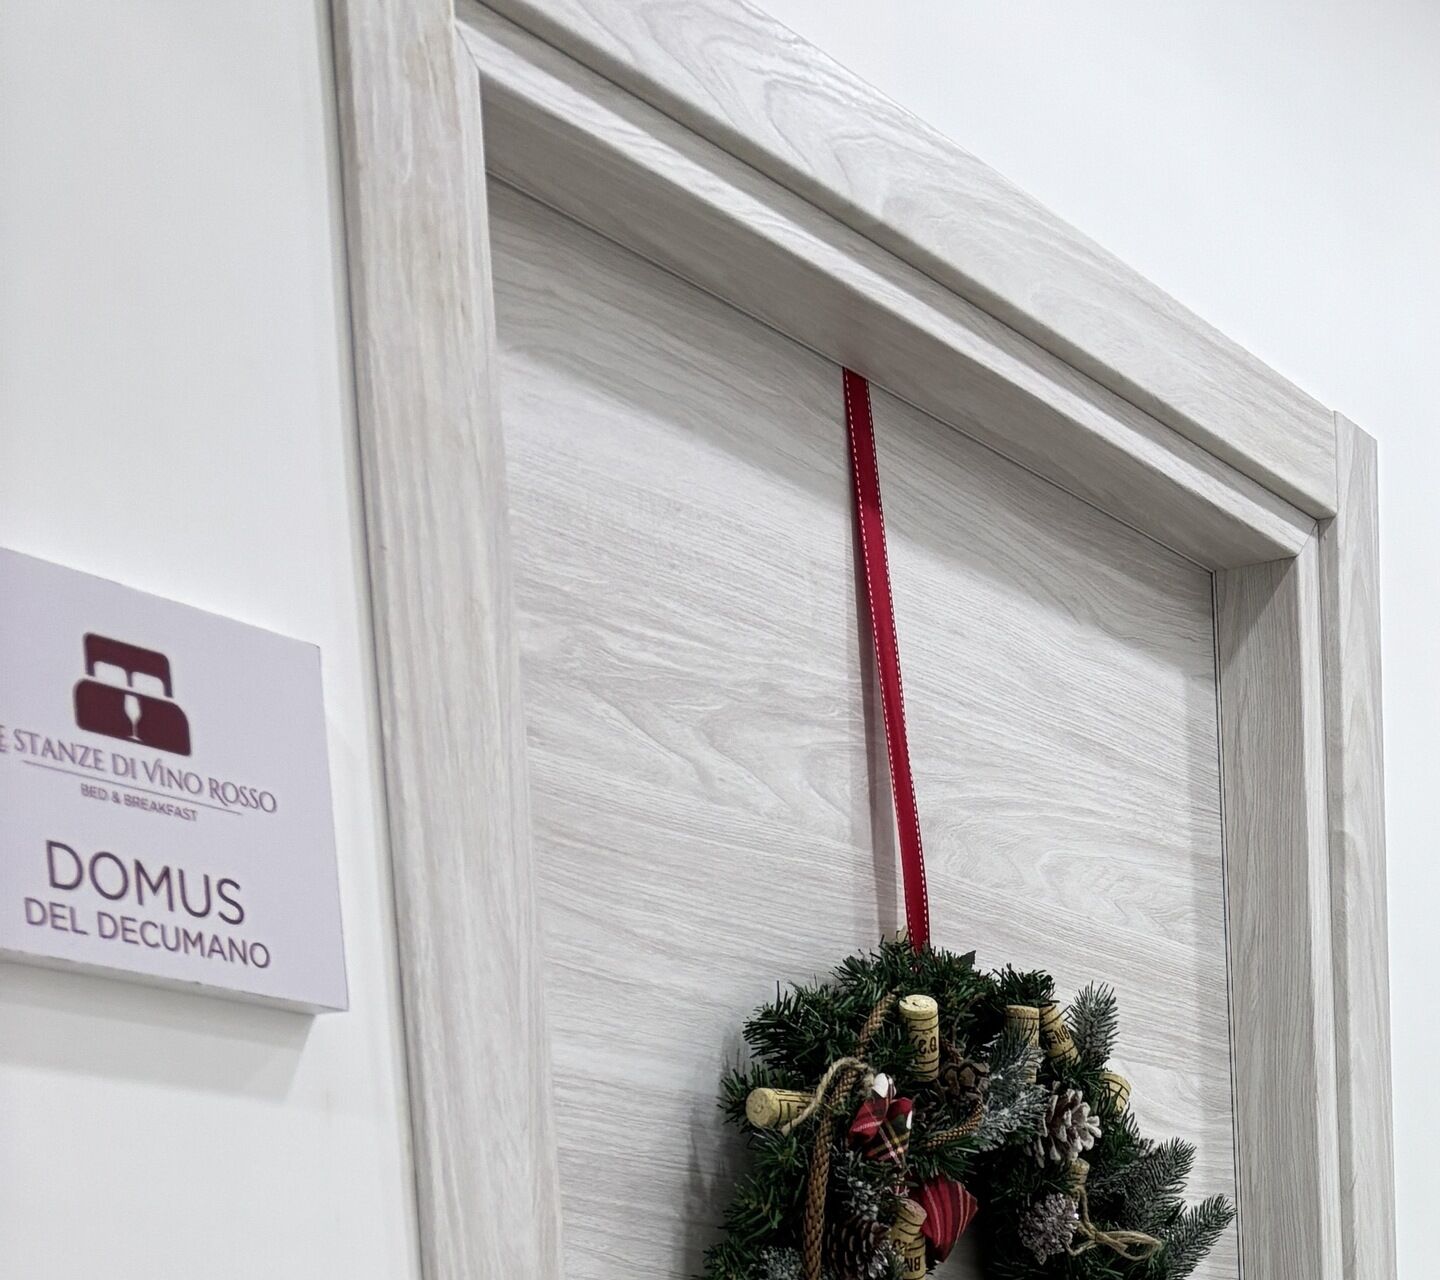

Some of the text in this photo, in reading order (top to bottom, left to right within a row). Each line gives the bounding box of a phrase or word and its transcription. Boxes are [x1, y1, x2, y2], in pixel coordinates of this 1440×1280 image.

[13, 728, 106, 772] STANZE
[111, 753, 138, 780] DI
[208, 776, 277, 813] ROSSO
[80, 783, 199, 821] BED & BREAKFAST
[46, 839, 245, 925] DOMUS
[24, 896, 271, 969] DEL DECUMANO
